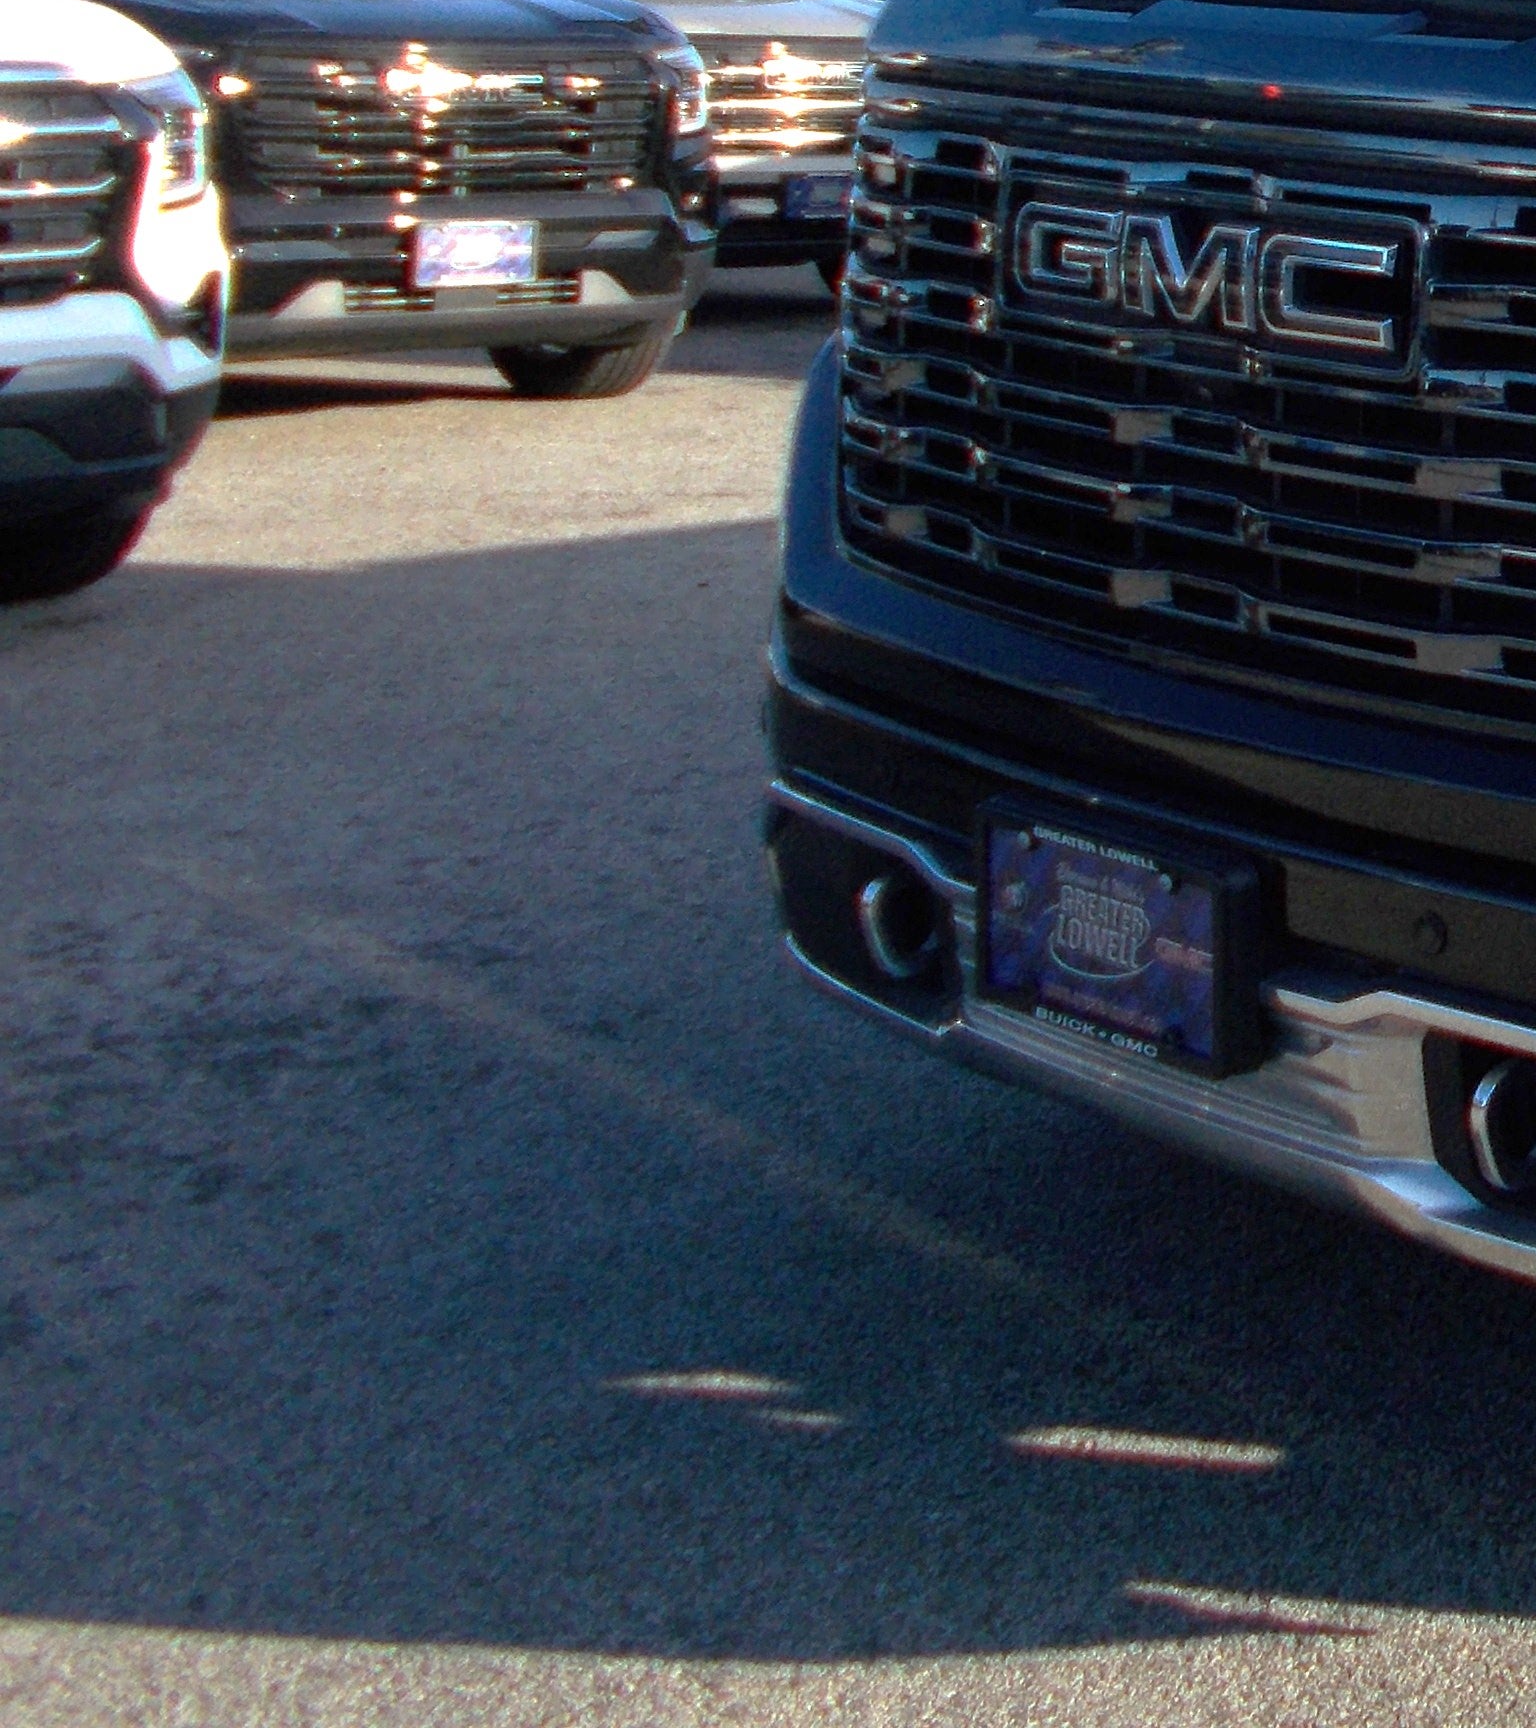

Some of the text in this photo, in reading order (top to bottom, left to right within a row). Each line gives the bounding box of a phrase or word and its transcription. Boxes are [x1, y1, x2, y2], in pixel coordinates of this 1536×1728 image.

[1012, 200, 1398, 351] GMC
[1032, 825, 1159, 873] GREATER LOWELL
[1060, 884, 1147, 937] GREATER
[1055, 913, 1142, 971] LOWELL
[1035, 1005, 1096, 1038] BUICK
[1110, 1032, 1158, 1059] GMC
